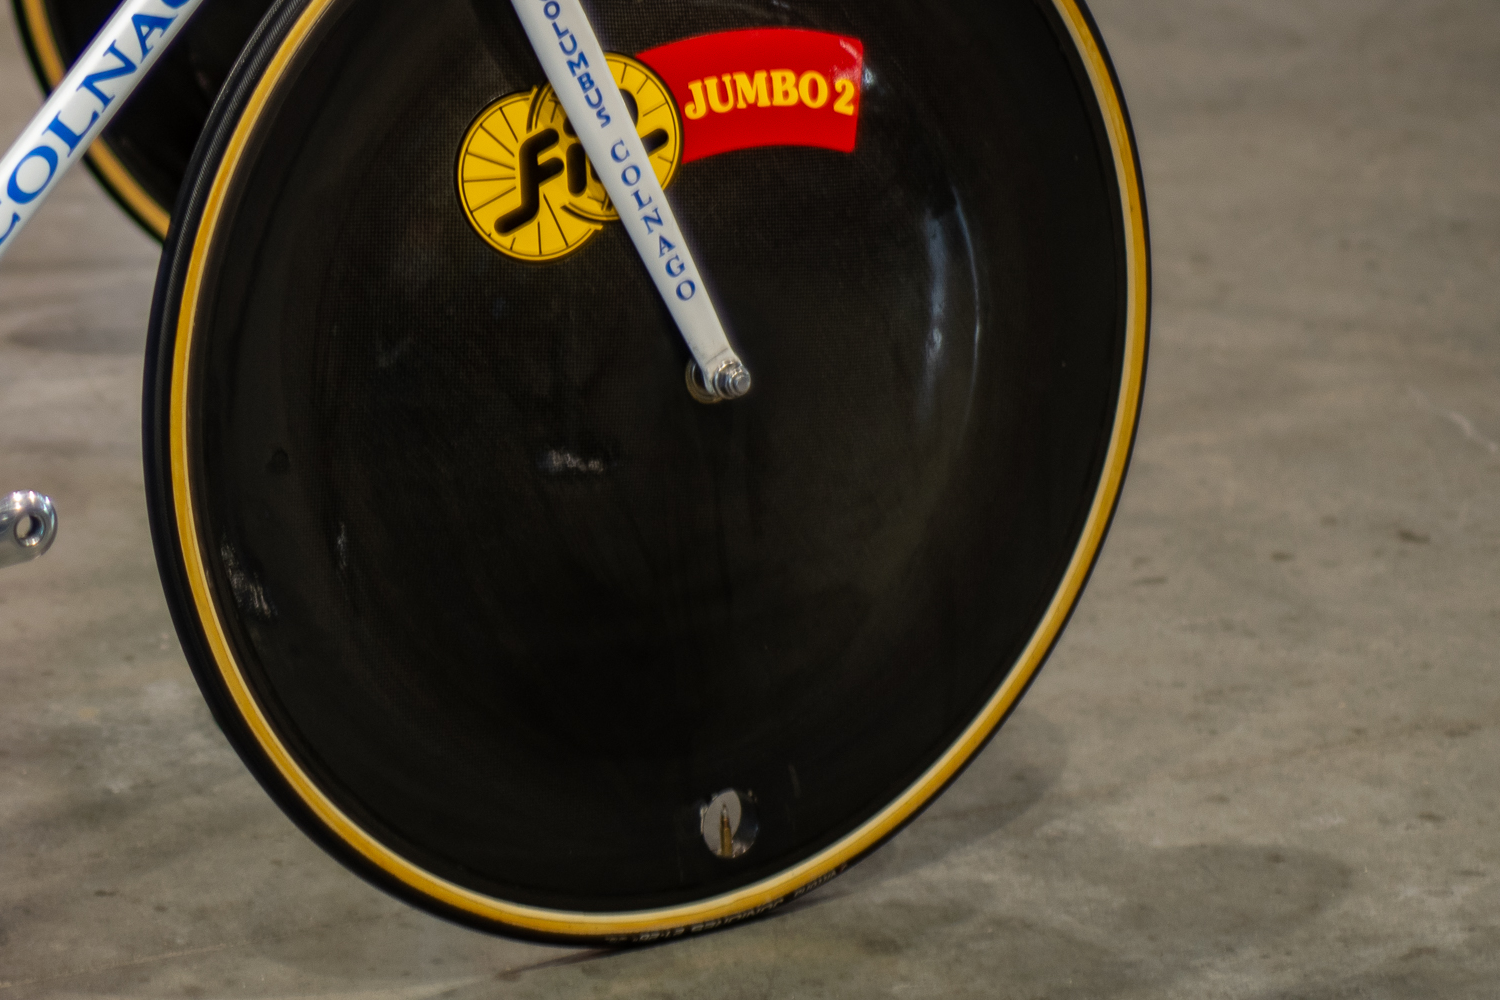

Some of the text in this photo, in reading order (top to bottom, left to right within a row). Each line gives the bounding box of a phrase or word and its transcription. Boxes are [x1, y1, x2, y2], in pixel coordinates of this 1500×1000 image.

[684, 68, 856, 121] JUMBO 2
[610, 138, 698, 302] COLNAGO
